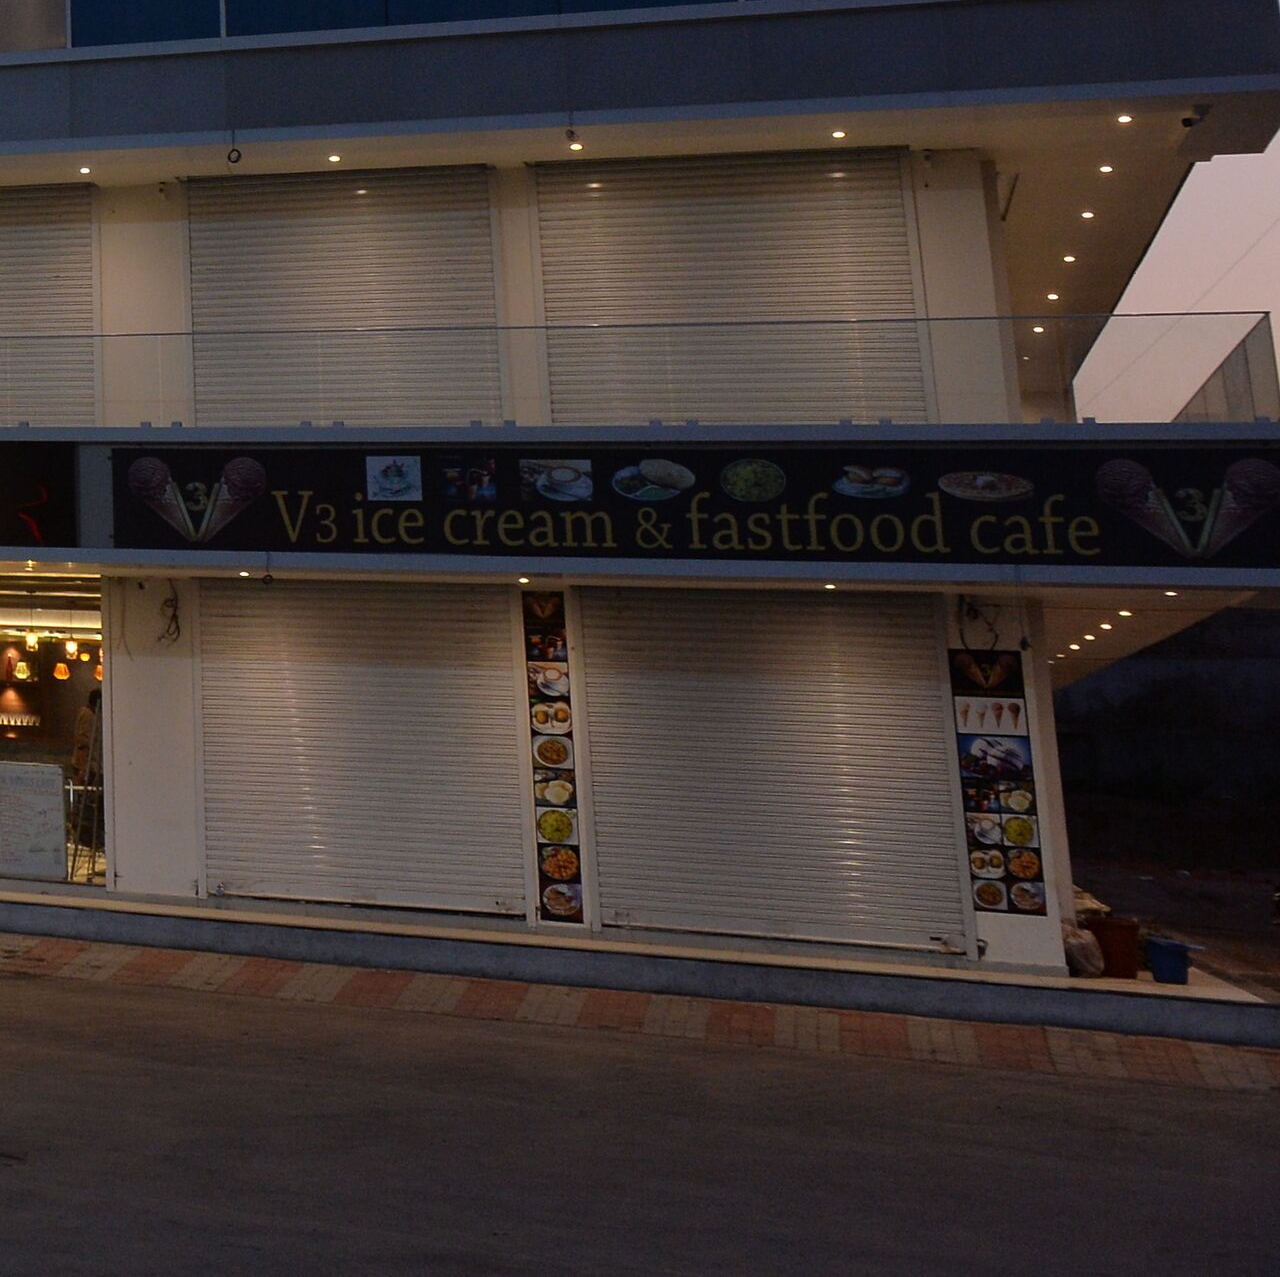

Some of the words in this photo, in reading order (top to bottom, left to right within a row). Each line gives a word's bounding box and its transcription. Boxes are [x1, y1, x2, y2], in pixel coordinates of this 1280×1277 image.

[271, 490, 340, 543] V3
[351, 492, 426, 544] ice
[442, 505, 618, 549] cream
[635, 506, 674, 550] &
[685, 491, 952, 555] fastfood
[969, 493, 1102, 557] cafe
